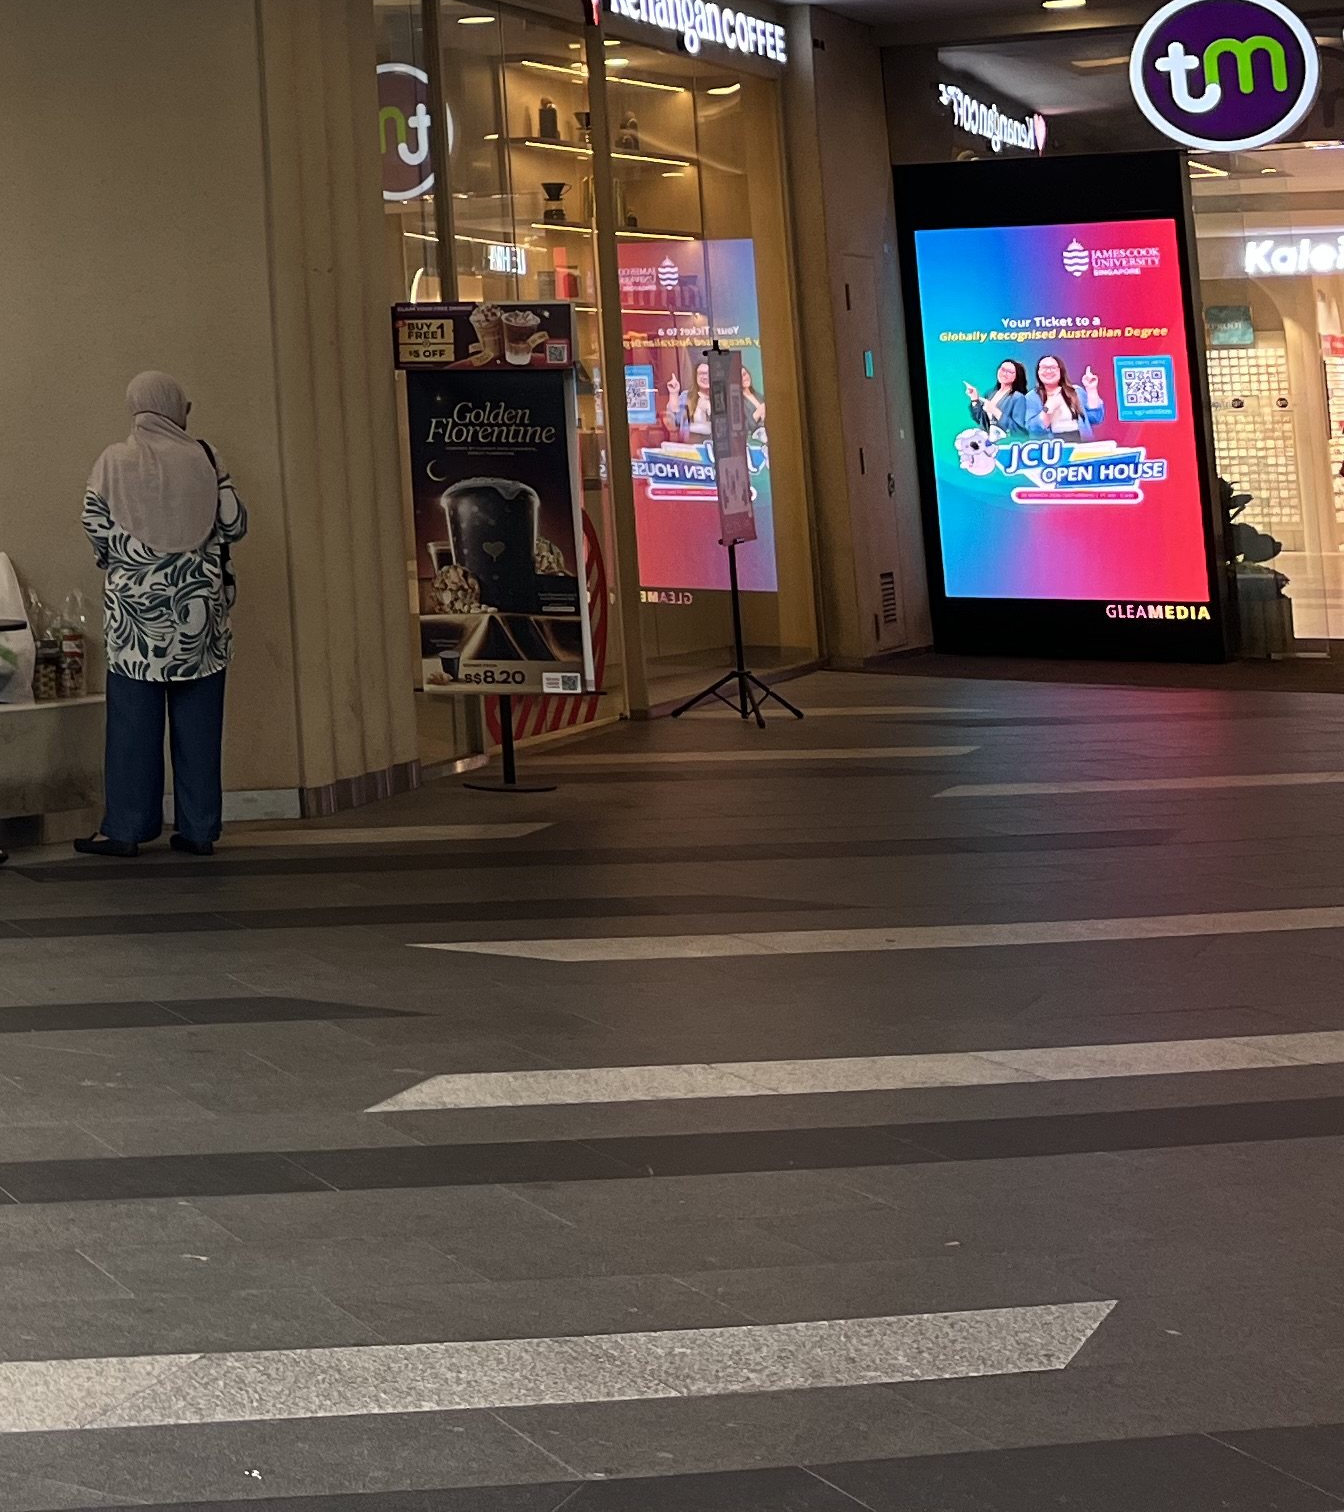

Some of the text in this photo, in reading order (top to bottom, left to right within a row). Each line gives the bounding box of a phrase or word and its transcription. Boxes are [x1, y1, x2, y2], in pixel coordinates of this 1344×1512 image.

[722, 7, 787, 64] COFFEE
[1155, 36, 1288, 114] tm
[1091, 247, 1160, 259] JAMES COOK
[1092, 257, 1160, 268] UNIVERSITY
[407, 322, 433, 331] BUY
[436, 322, 445, 340] 1
[1001, 316, 1101, 329] Your Ticket to a
[407, 331, 438, 340] FREE
[939, 325, 1169, 343] Globally Recognised Australian Degree
[423, 349, 446, 358] OFF
[453, 401, 530, 425] Golden
[425, 418, 556, 444] Florentine
[1005, 441, 1062, 473] JCU
[1041, 462, 1164, 483] OPEN HOUSE
[1105, 604, 1212, 620] GLEAMEDIA
